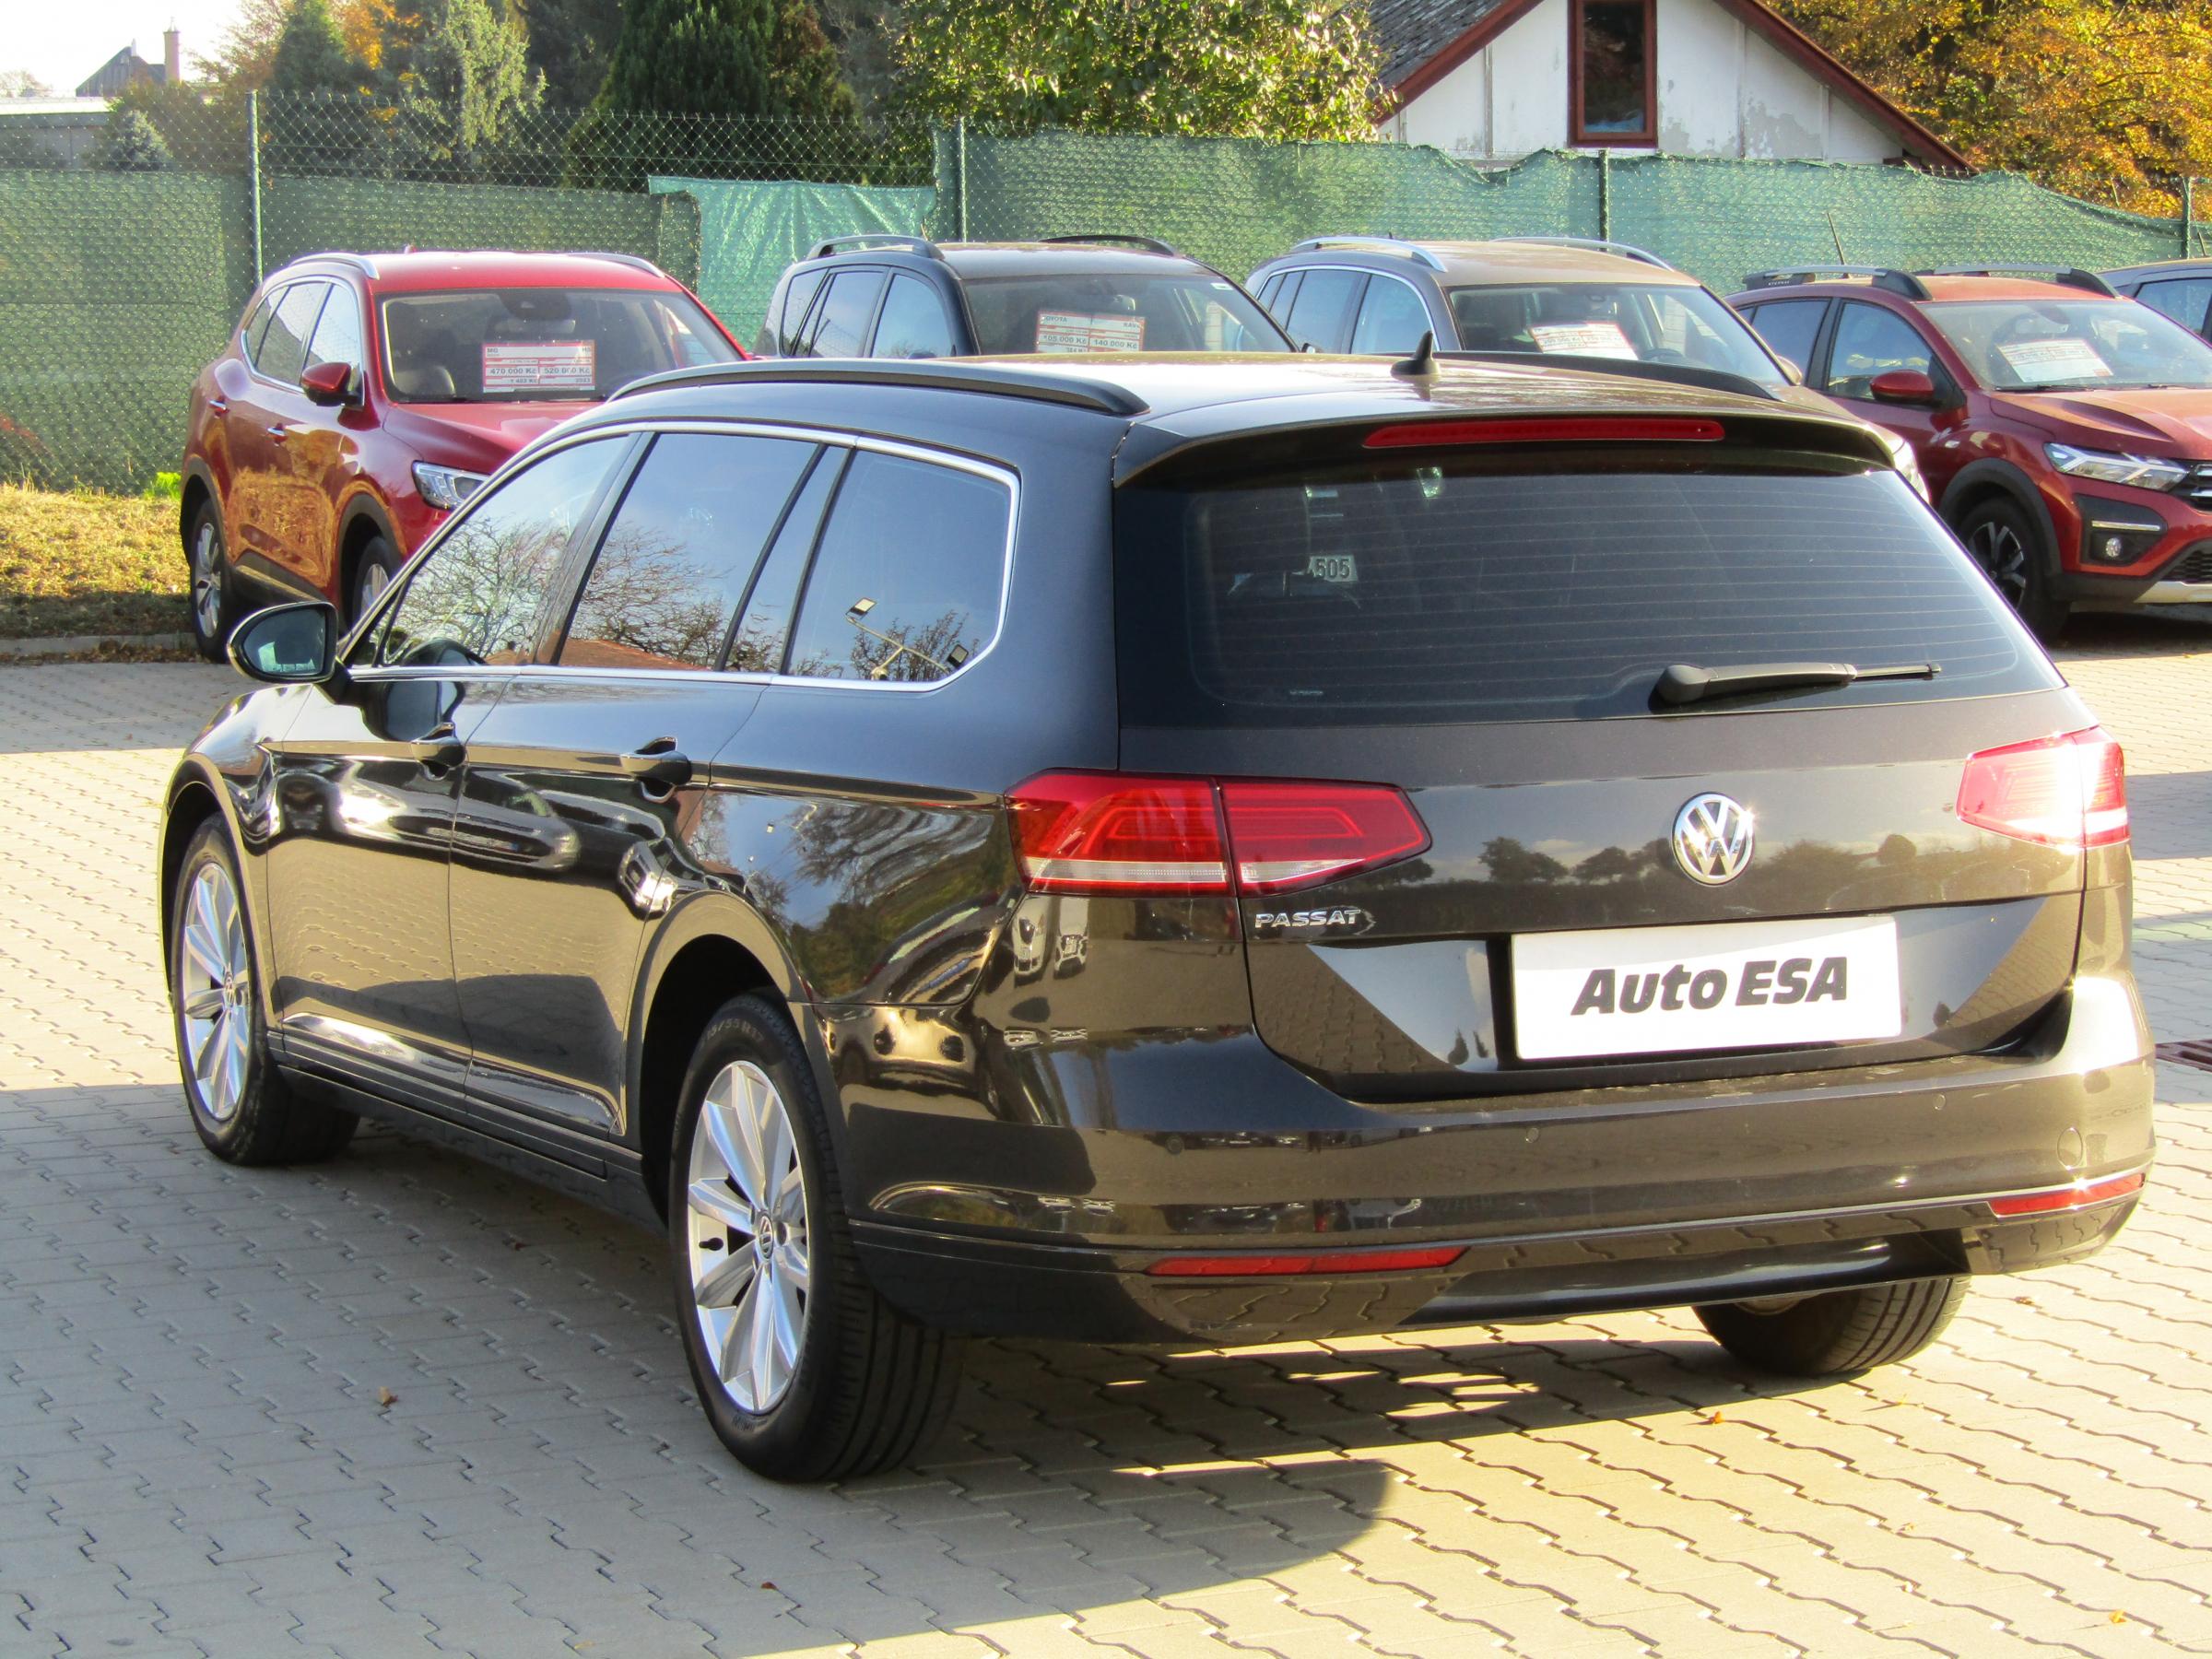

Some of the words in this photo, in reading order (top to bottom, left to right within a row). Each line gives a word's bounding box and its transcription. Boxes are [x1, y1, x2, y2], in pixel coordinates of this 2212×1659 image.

[1060, 335, 1075, 343] 000
[1254, 909, 1361, 928] PASSAT
[1571, 964, 1728, 1016] Auto
[1735, 956, 1847, 1006] ESA
